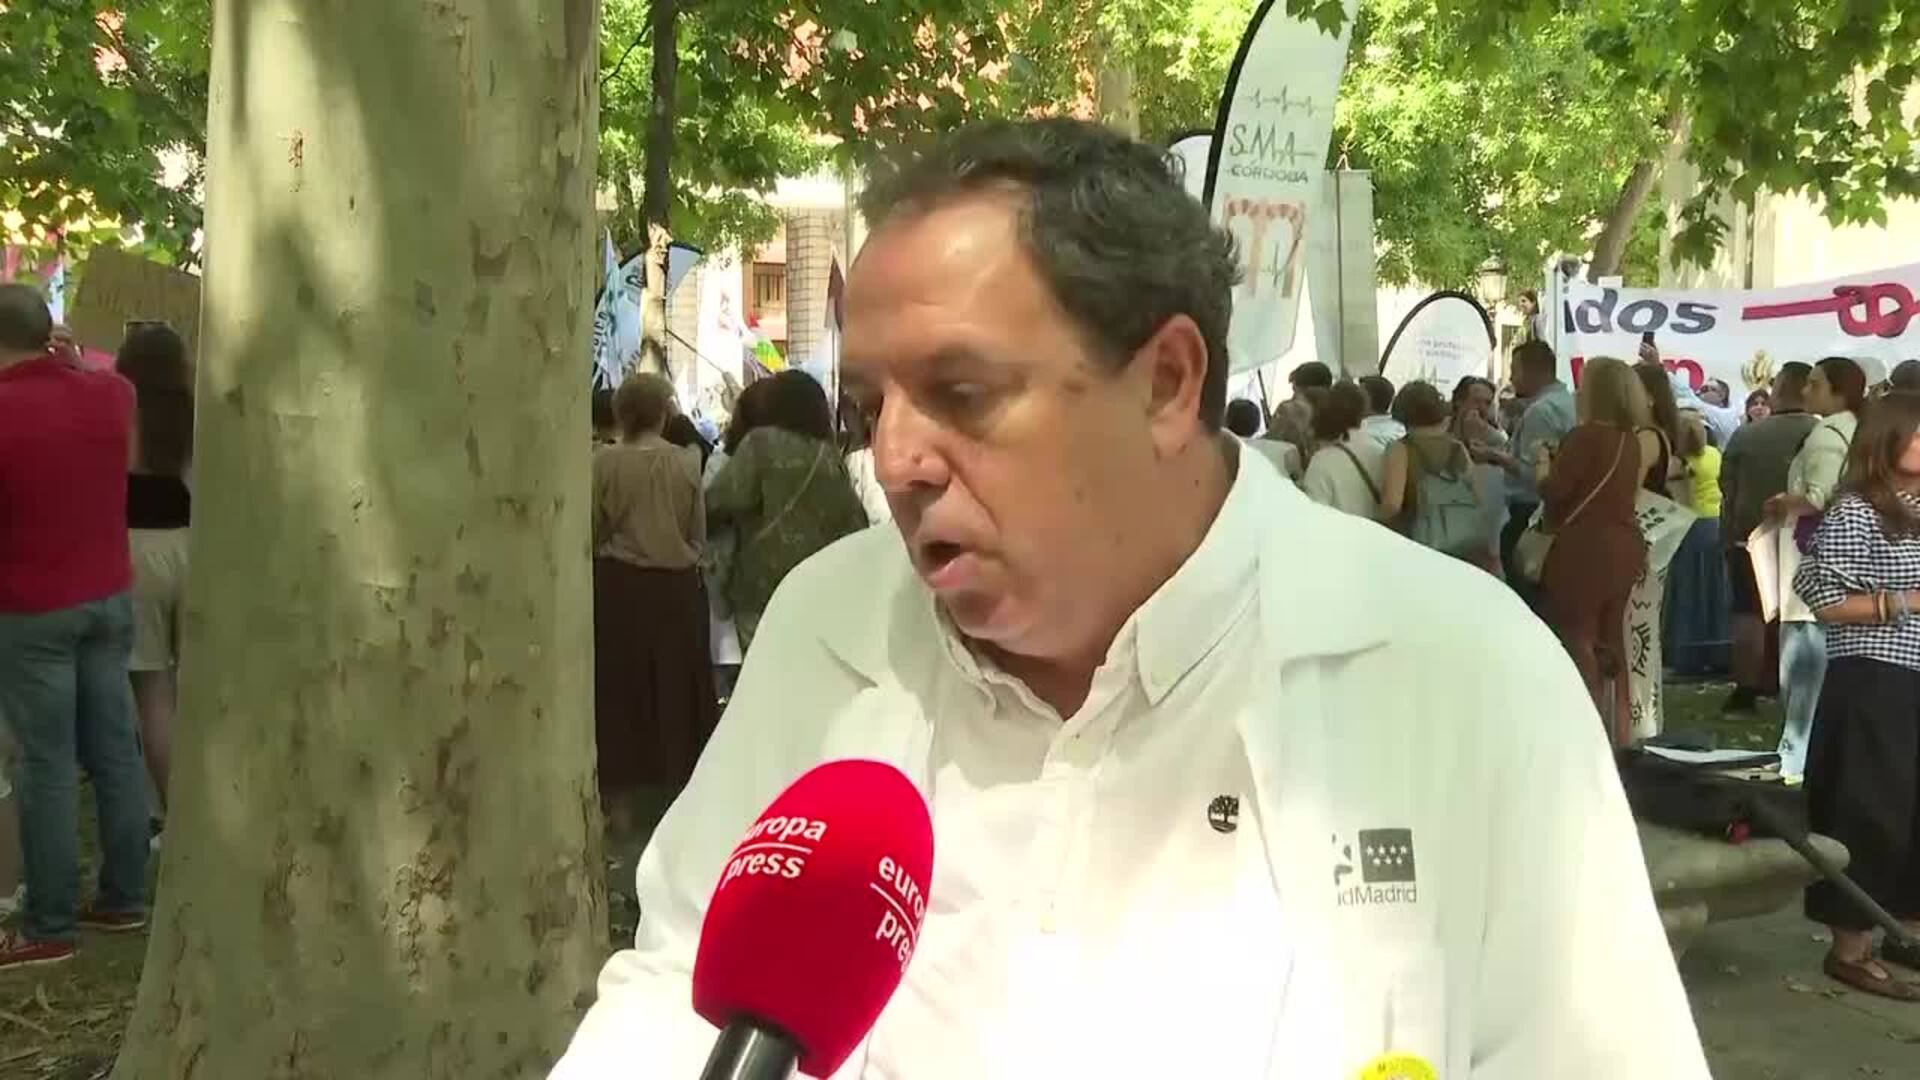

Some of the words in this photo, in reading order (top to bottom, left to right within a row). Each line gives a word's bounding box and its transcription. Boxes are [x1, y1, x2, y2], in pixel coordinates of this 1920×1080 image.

[1230, 121, 1312, 167] SMA
[744, 816, 827, 841] uropa
[720, 853, 804, 891] press
[879, 856, 924, 933] euro
